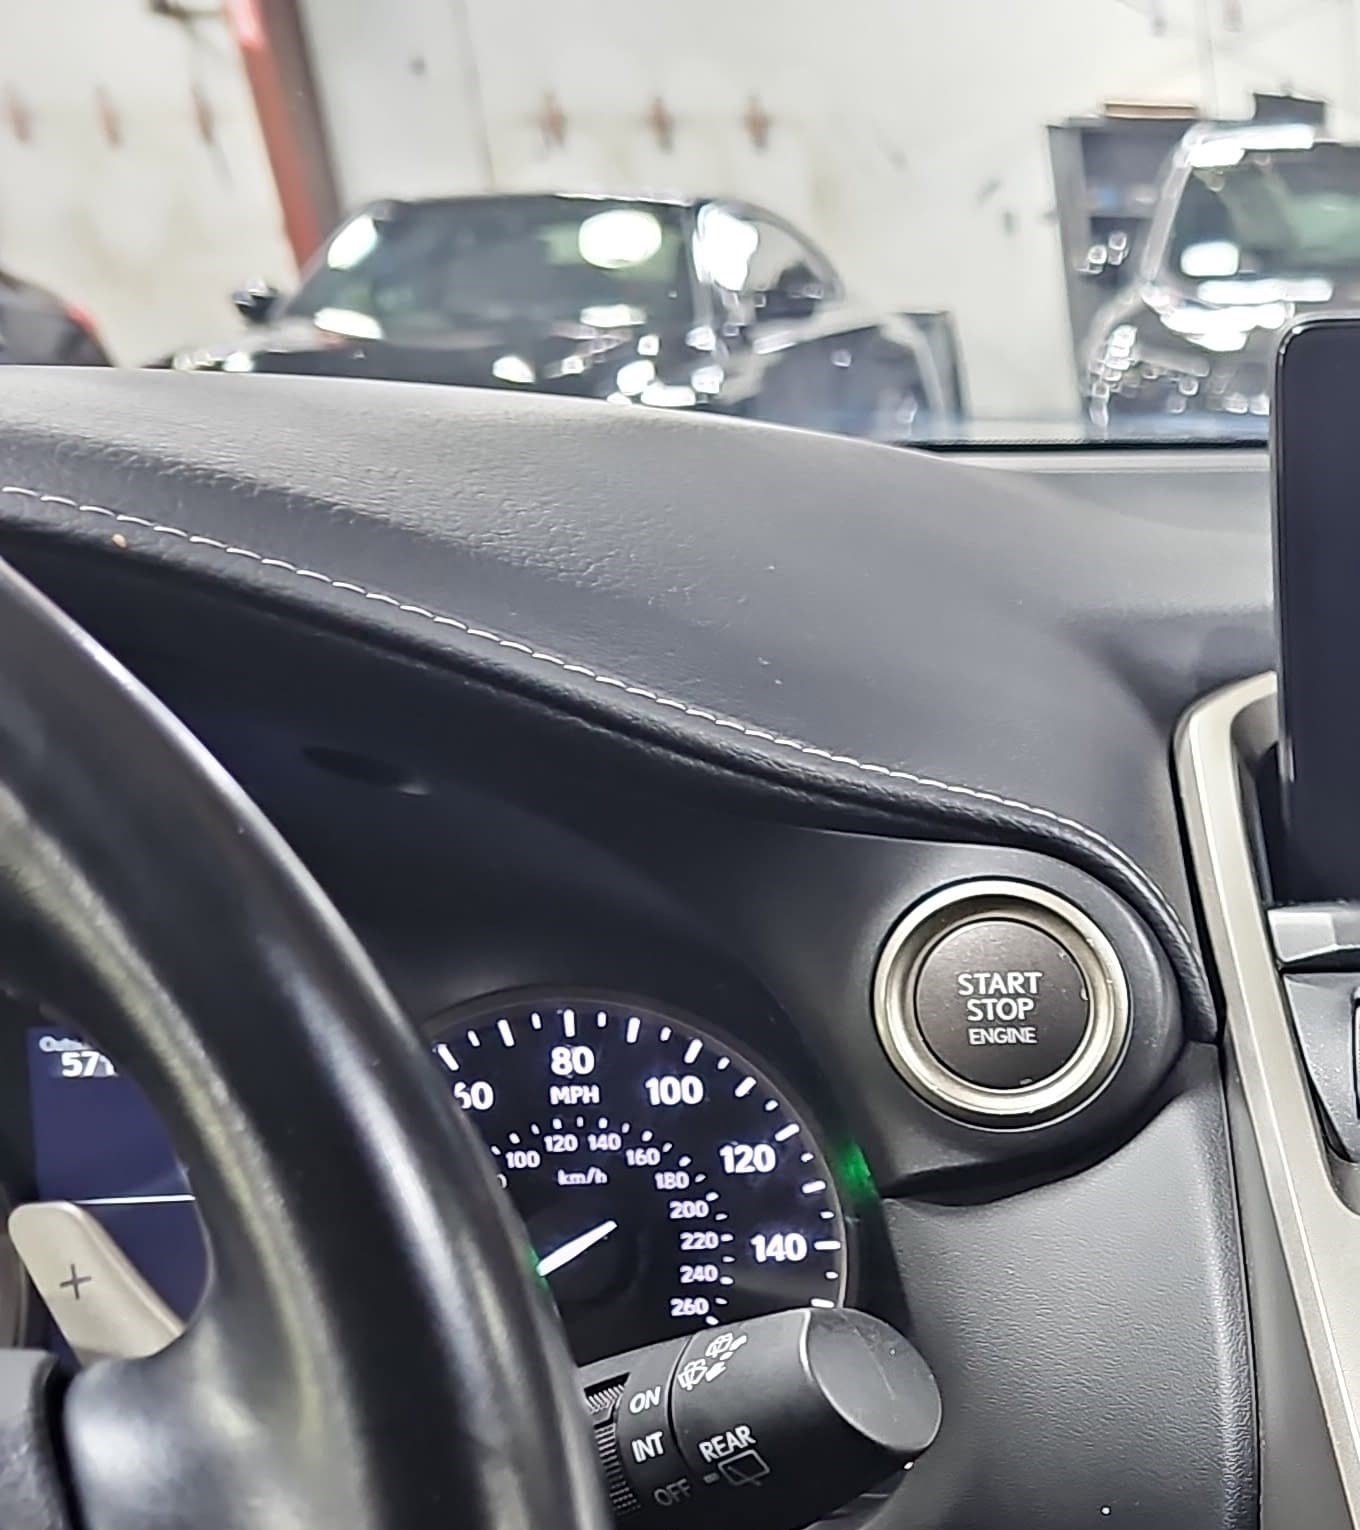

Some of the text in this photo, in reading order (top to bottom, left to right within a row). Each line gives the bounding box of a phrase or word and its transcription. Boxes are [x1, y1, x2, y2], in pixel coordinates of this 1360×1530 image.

[957, 971, 1043, 995] START
[967, 998, 1034, 1022] STOP
[968, 1026, 1038, 1046] ENGINE
[549, 1045, 596, 1077] 80
[549, 1085, 600, 1105] MPH
[644, 1075, 704, 1106] 100
[543, 1133, 579, 1153] 120
[588, 1132, 623, 1152] 140
[505, 1150, 541, 1169] 100
[625, 1146, 661, 1167] 160
[719, 1143, 776, 1174] 120
[557, 1167, 608, 1186] km/h
[654, 1170, 690, 1191] 180
[669, 1198, 710, 1221] 200
[680, 1230, 720, 1251] 220
[750, 1231, 808, 1263] 140
[679, 1263, 719, 1284] 240
[670, 1296, 710, 1317] 260
[629, 1385, 662, 1415] ON
[631, 1431, 664, 1463] INT
[698, 1424, 757, 1463] REAR
[653, 1477, 692, 1507] OFF
